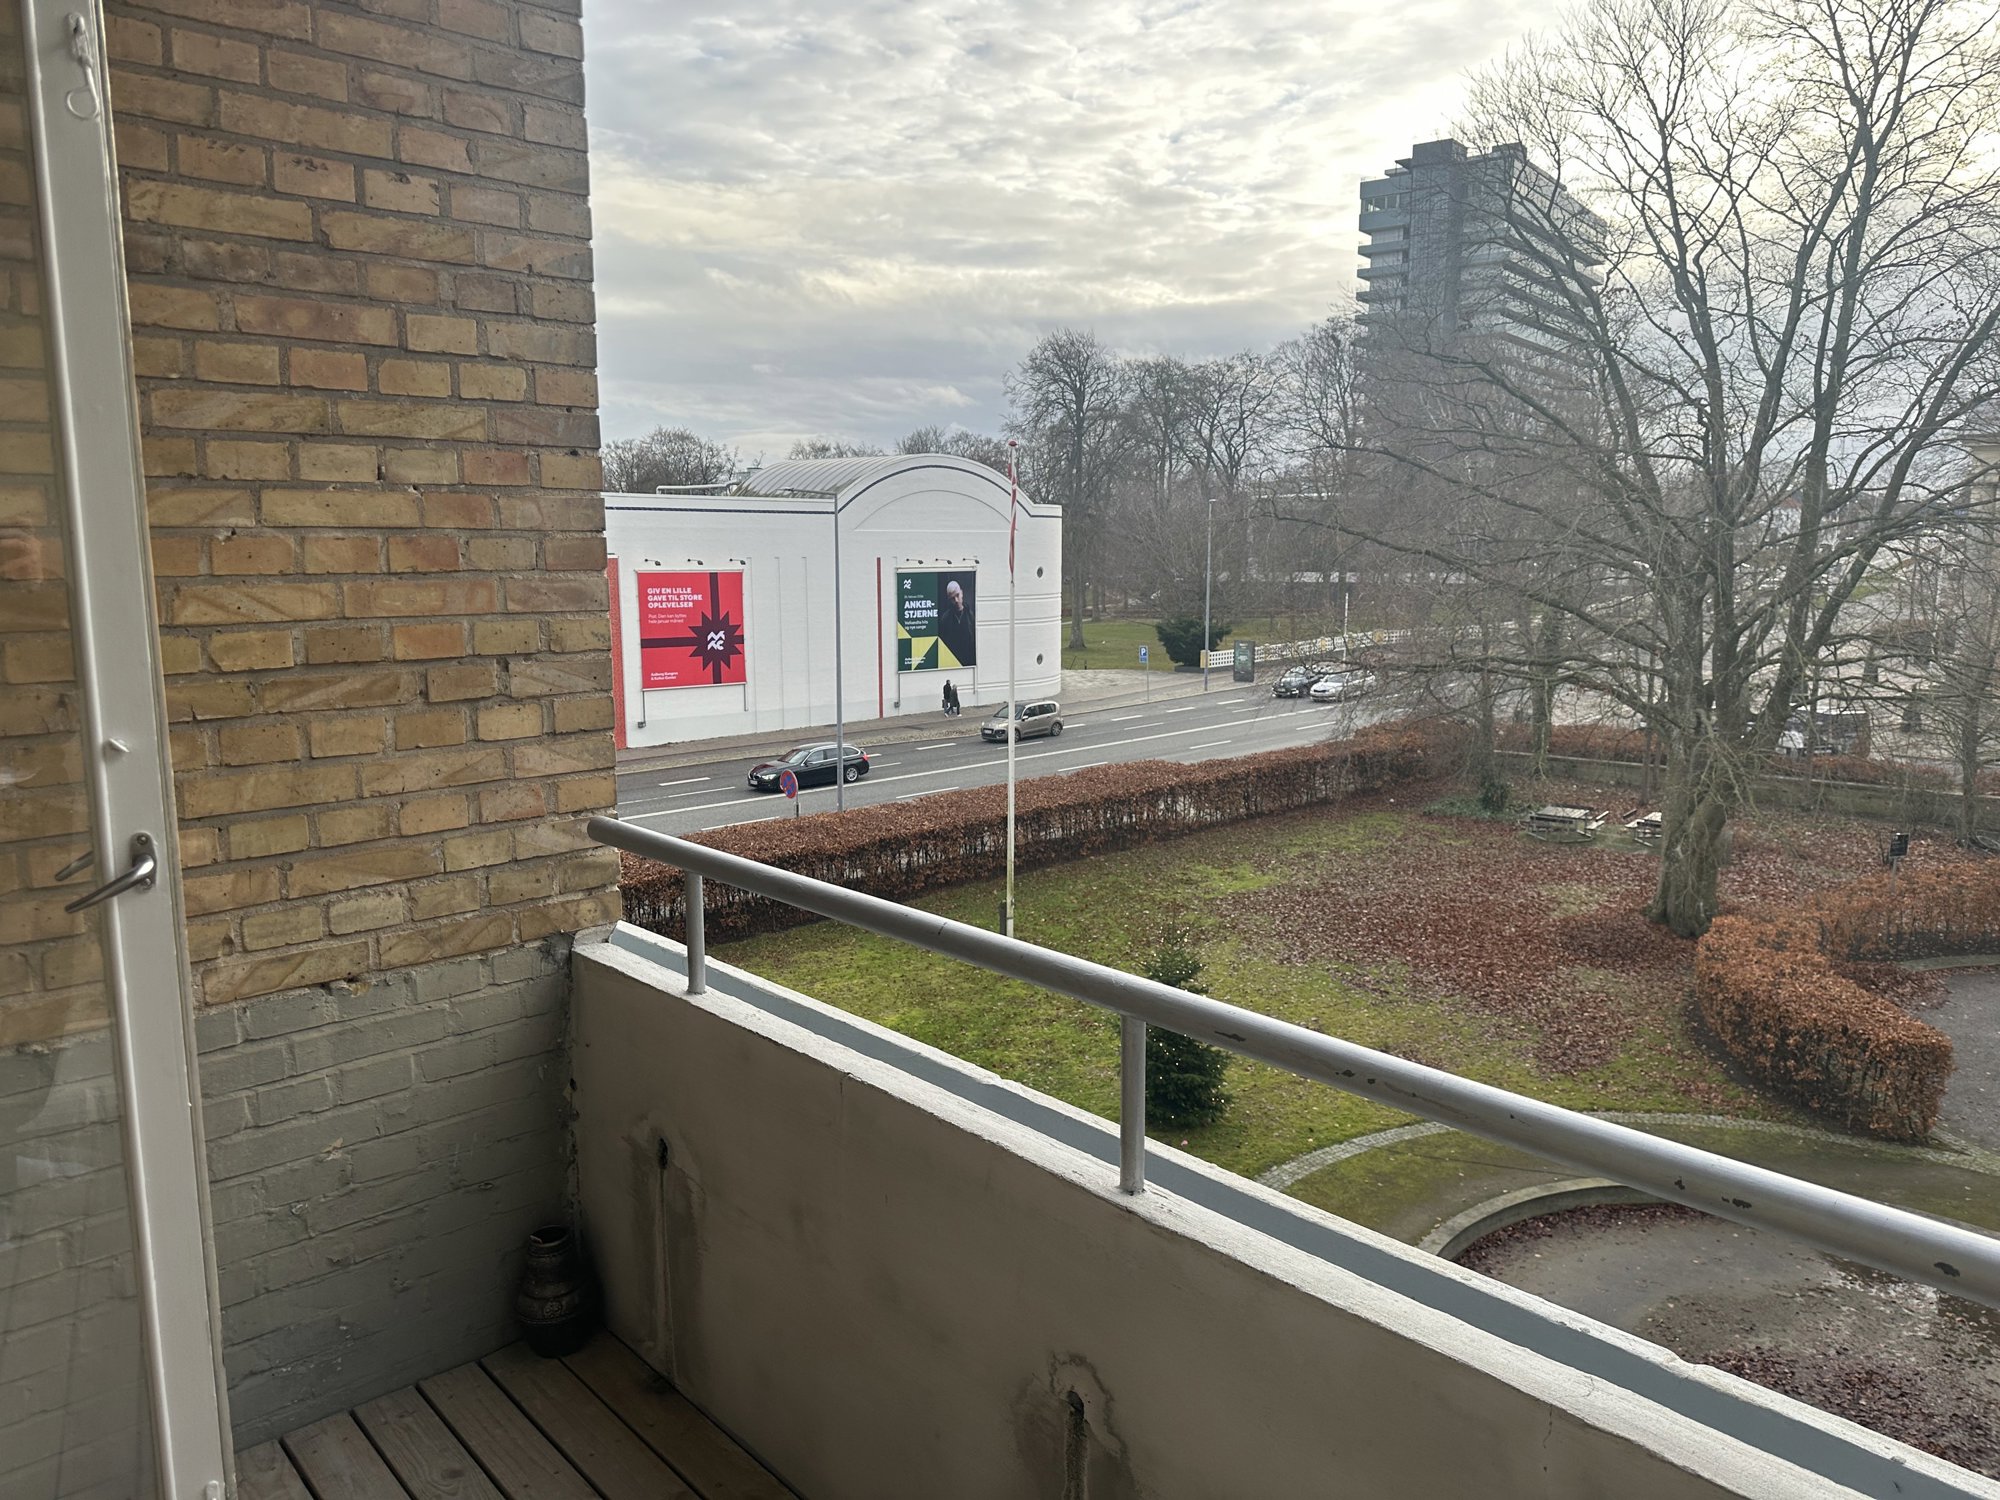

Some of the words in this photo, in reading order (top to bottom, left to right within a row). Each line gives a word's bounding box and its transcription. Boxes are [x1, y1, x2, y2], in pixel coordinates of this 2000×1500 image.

[647, 587, 660, 595] GIV
[904, 600, 935, 609] ANKER-
[904, 609, 938, 618] STJERNE
[1140, 647, 1146, 656] P
